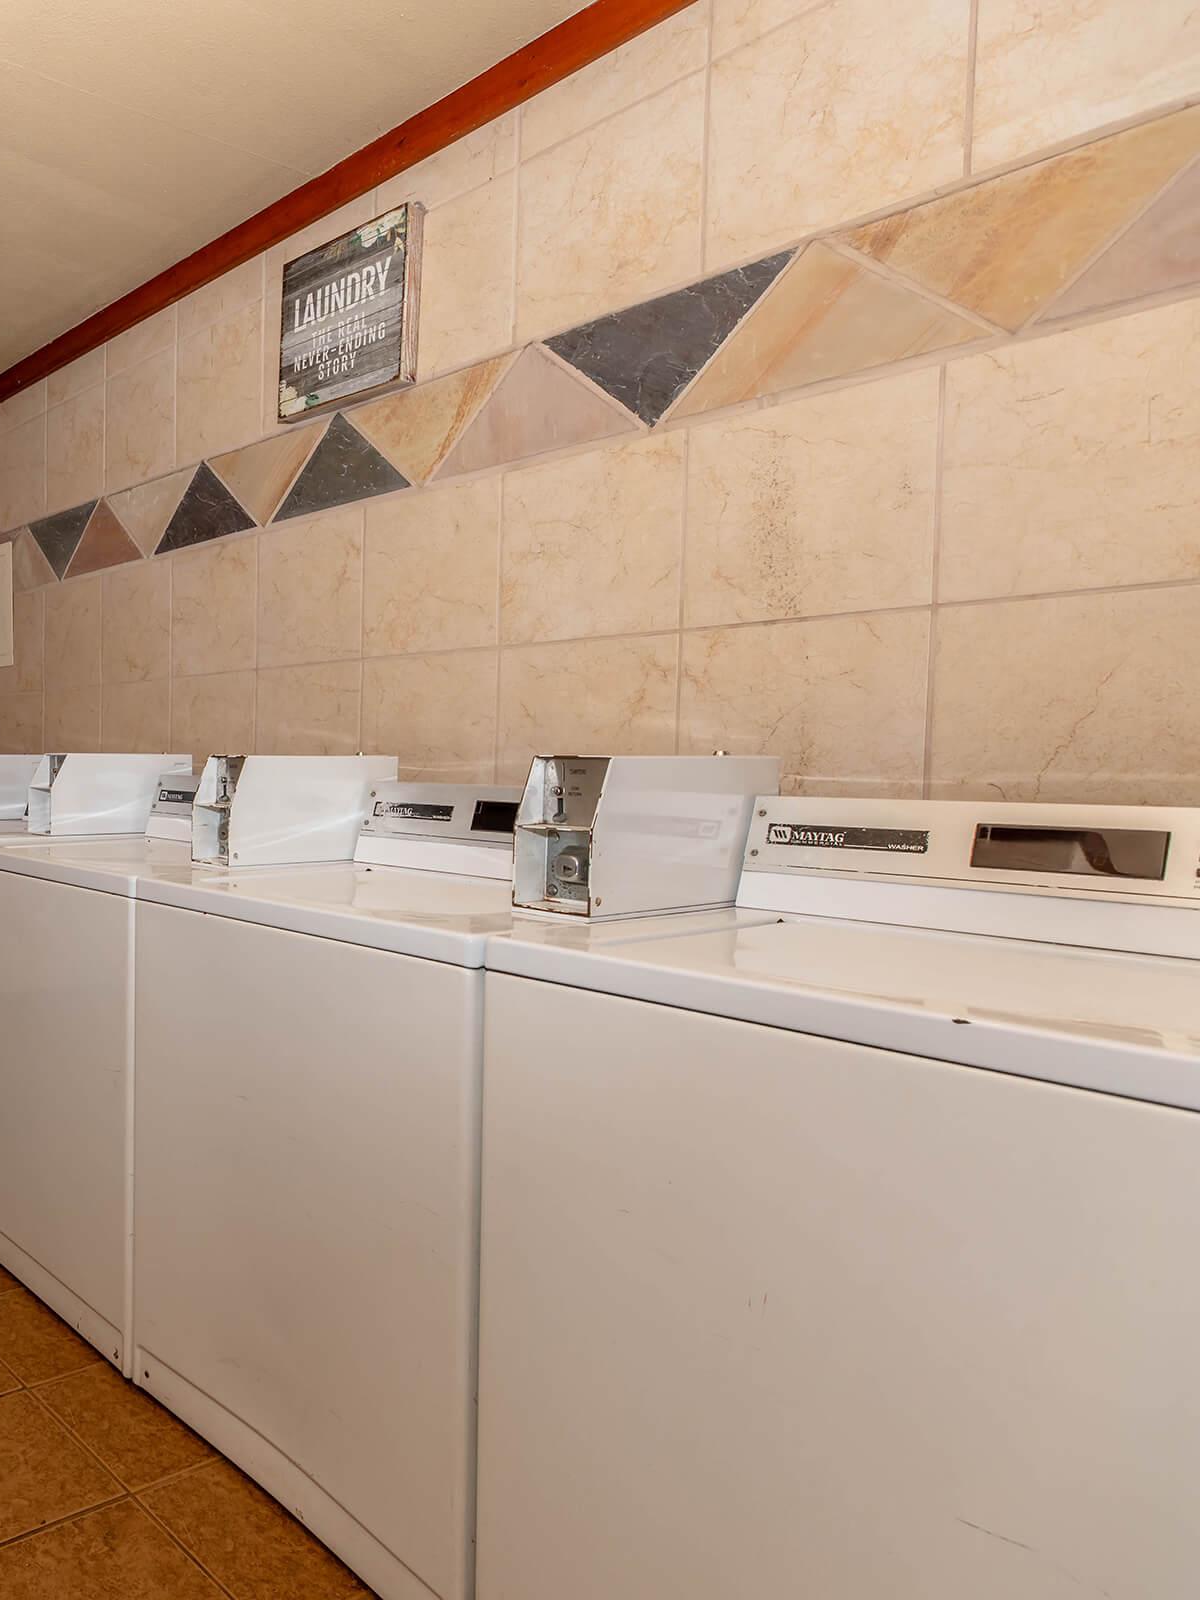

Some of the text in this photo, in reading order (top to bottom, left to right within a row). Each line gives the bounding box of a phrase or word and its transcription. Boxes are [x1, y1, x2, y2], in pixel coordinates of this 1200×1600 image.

[294, 256, 392, 333] LAUNDRY
[312, 312, 367, 348] THE REAL
[294, 322, 385, 372] NEVER-ENDING
[318, 351, 357, 380] STORY
[792, 830, 845, 843] MAYTAG
[887, 843, 924, 851] WASHER
